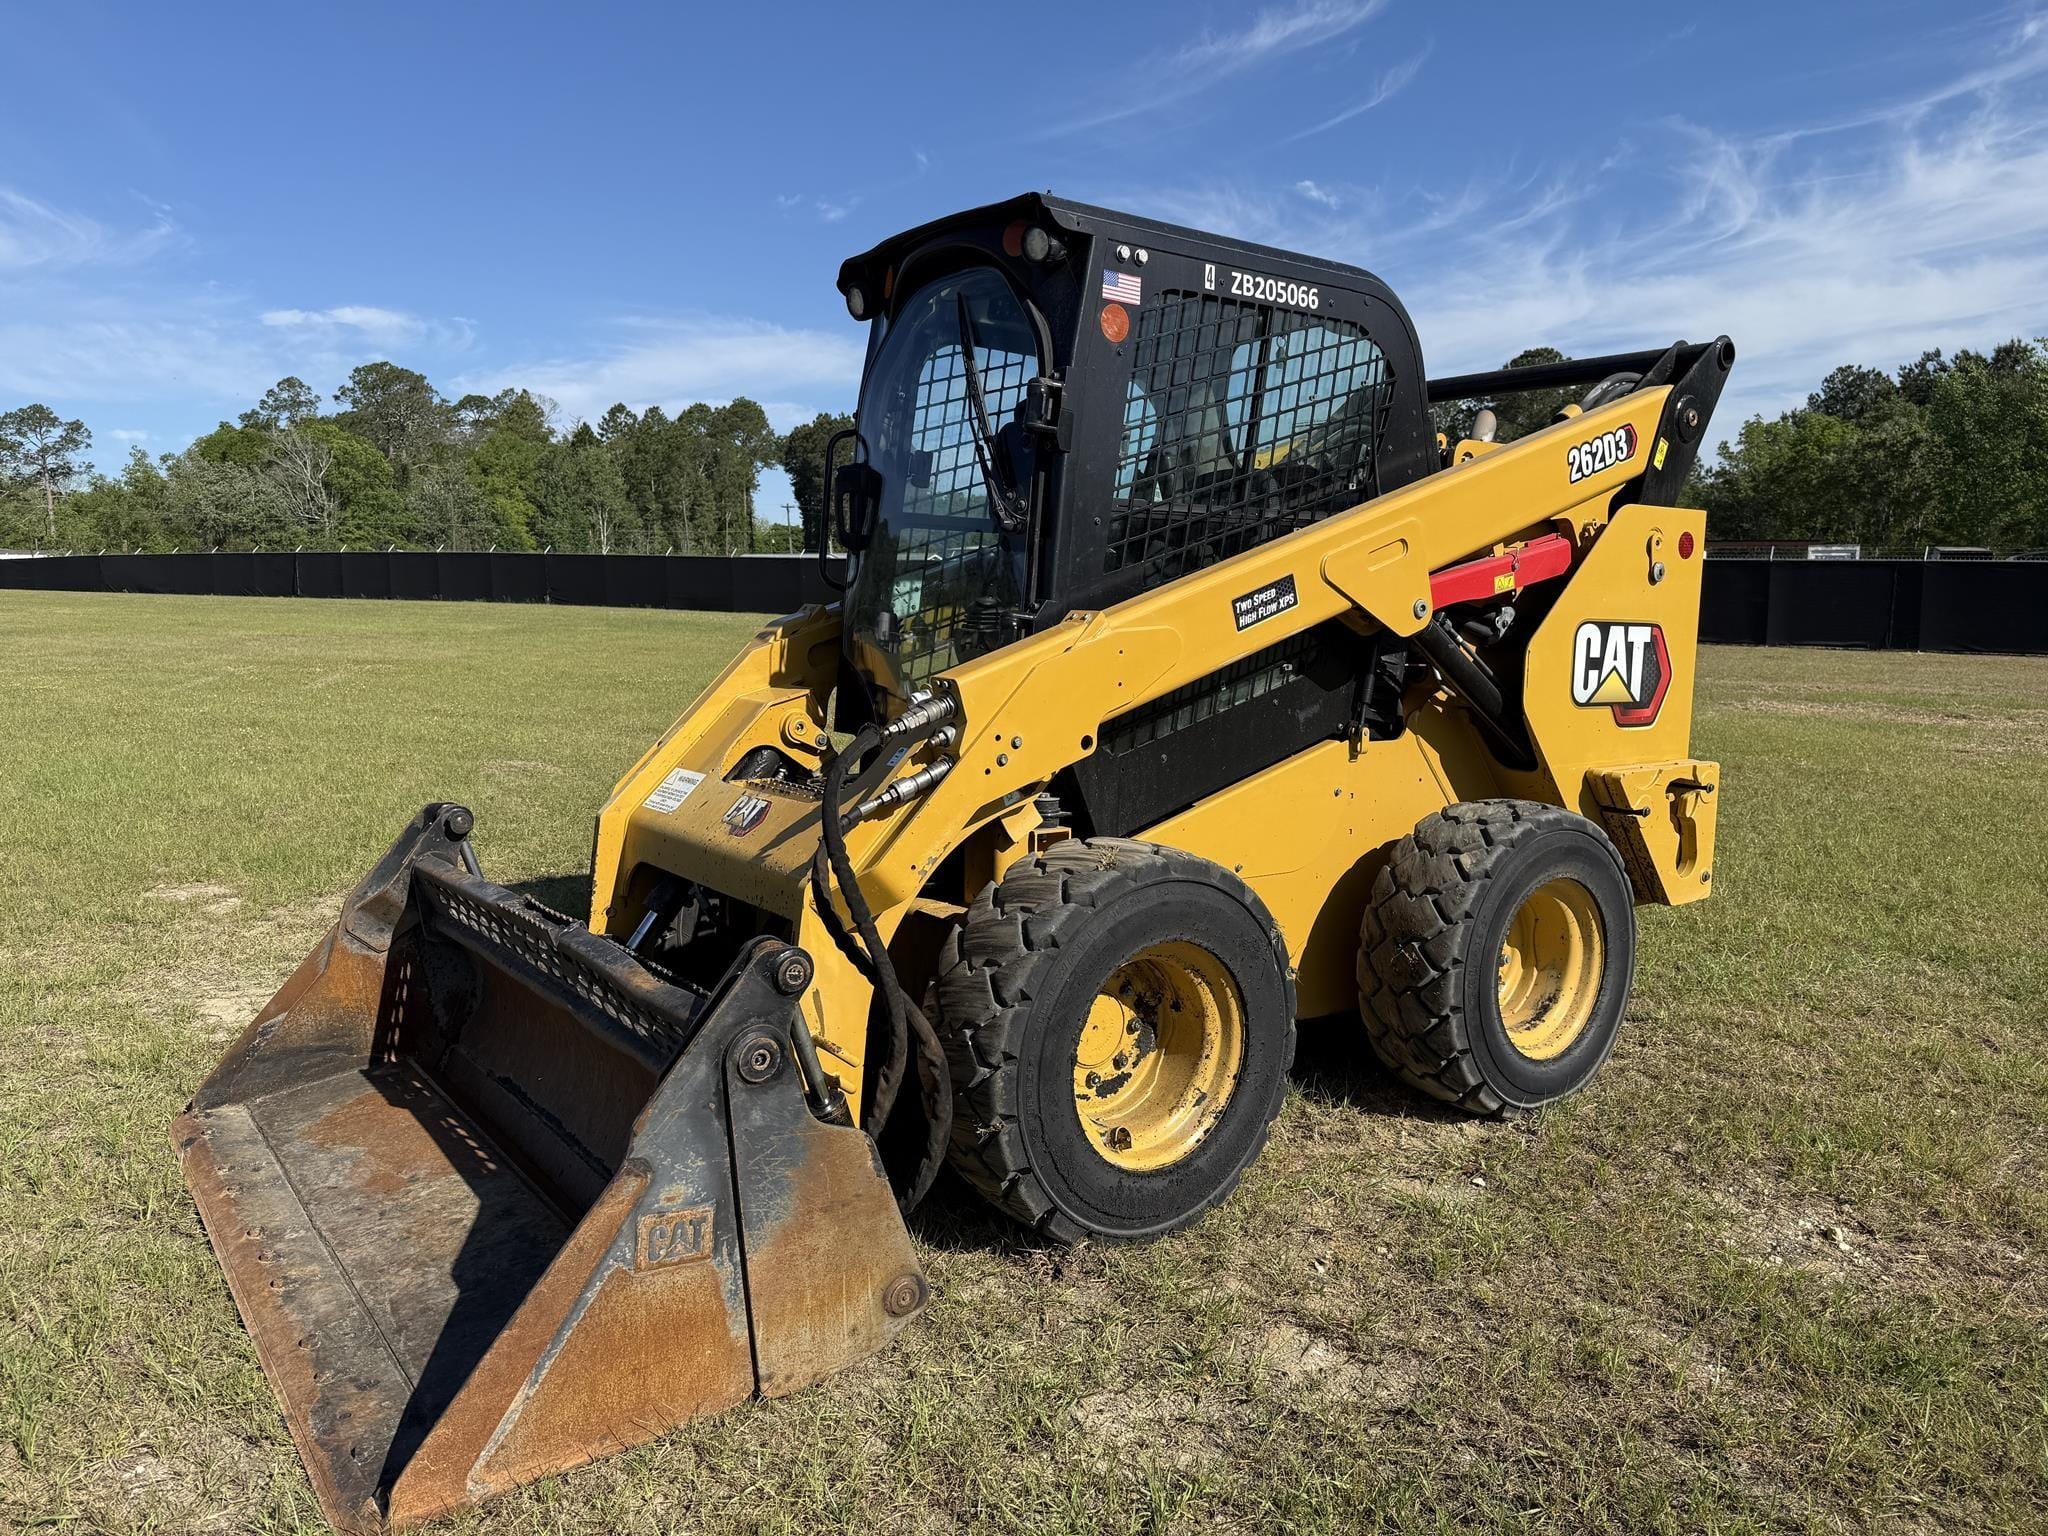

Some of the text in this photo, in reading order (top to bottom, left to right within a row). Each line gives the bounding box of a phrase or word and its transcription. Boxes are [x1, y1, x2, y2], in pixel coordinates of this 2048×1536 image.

[1206, 265, 1214, 289] 4
[1231, 271, 1319, 310] ZB205066
[1568, 428, 1628, 482] 262D3
[1279, 593, 1295, 609] XPS
[1572, 622, 1652, 704] CAT
[721, 794, 769, 829] CAT
[648, 1216, 707, 1264] CAT
